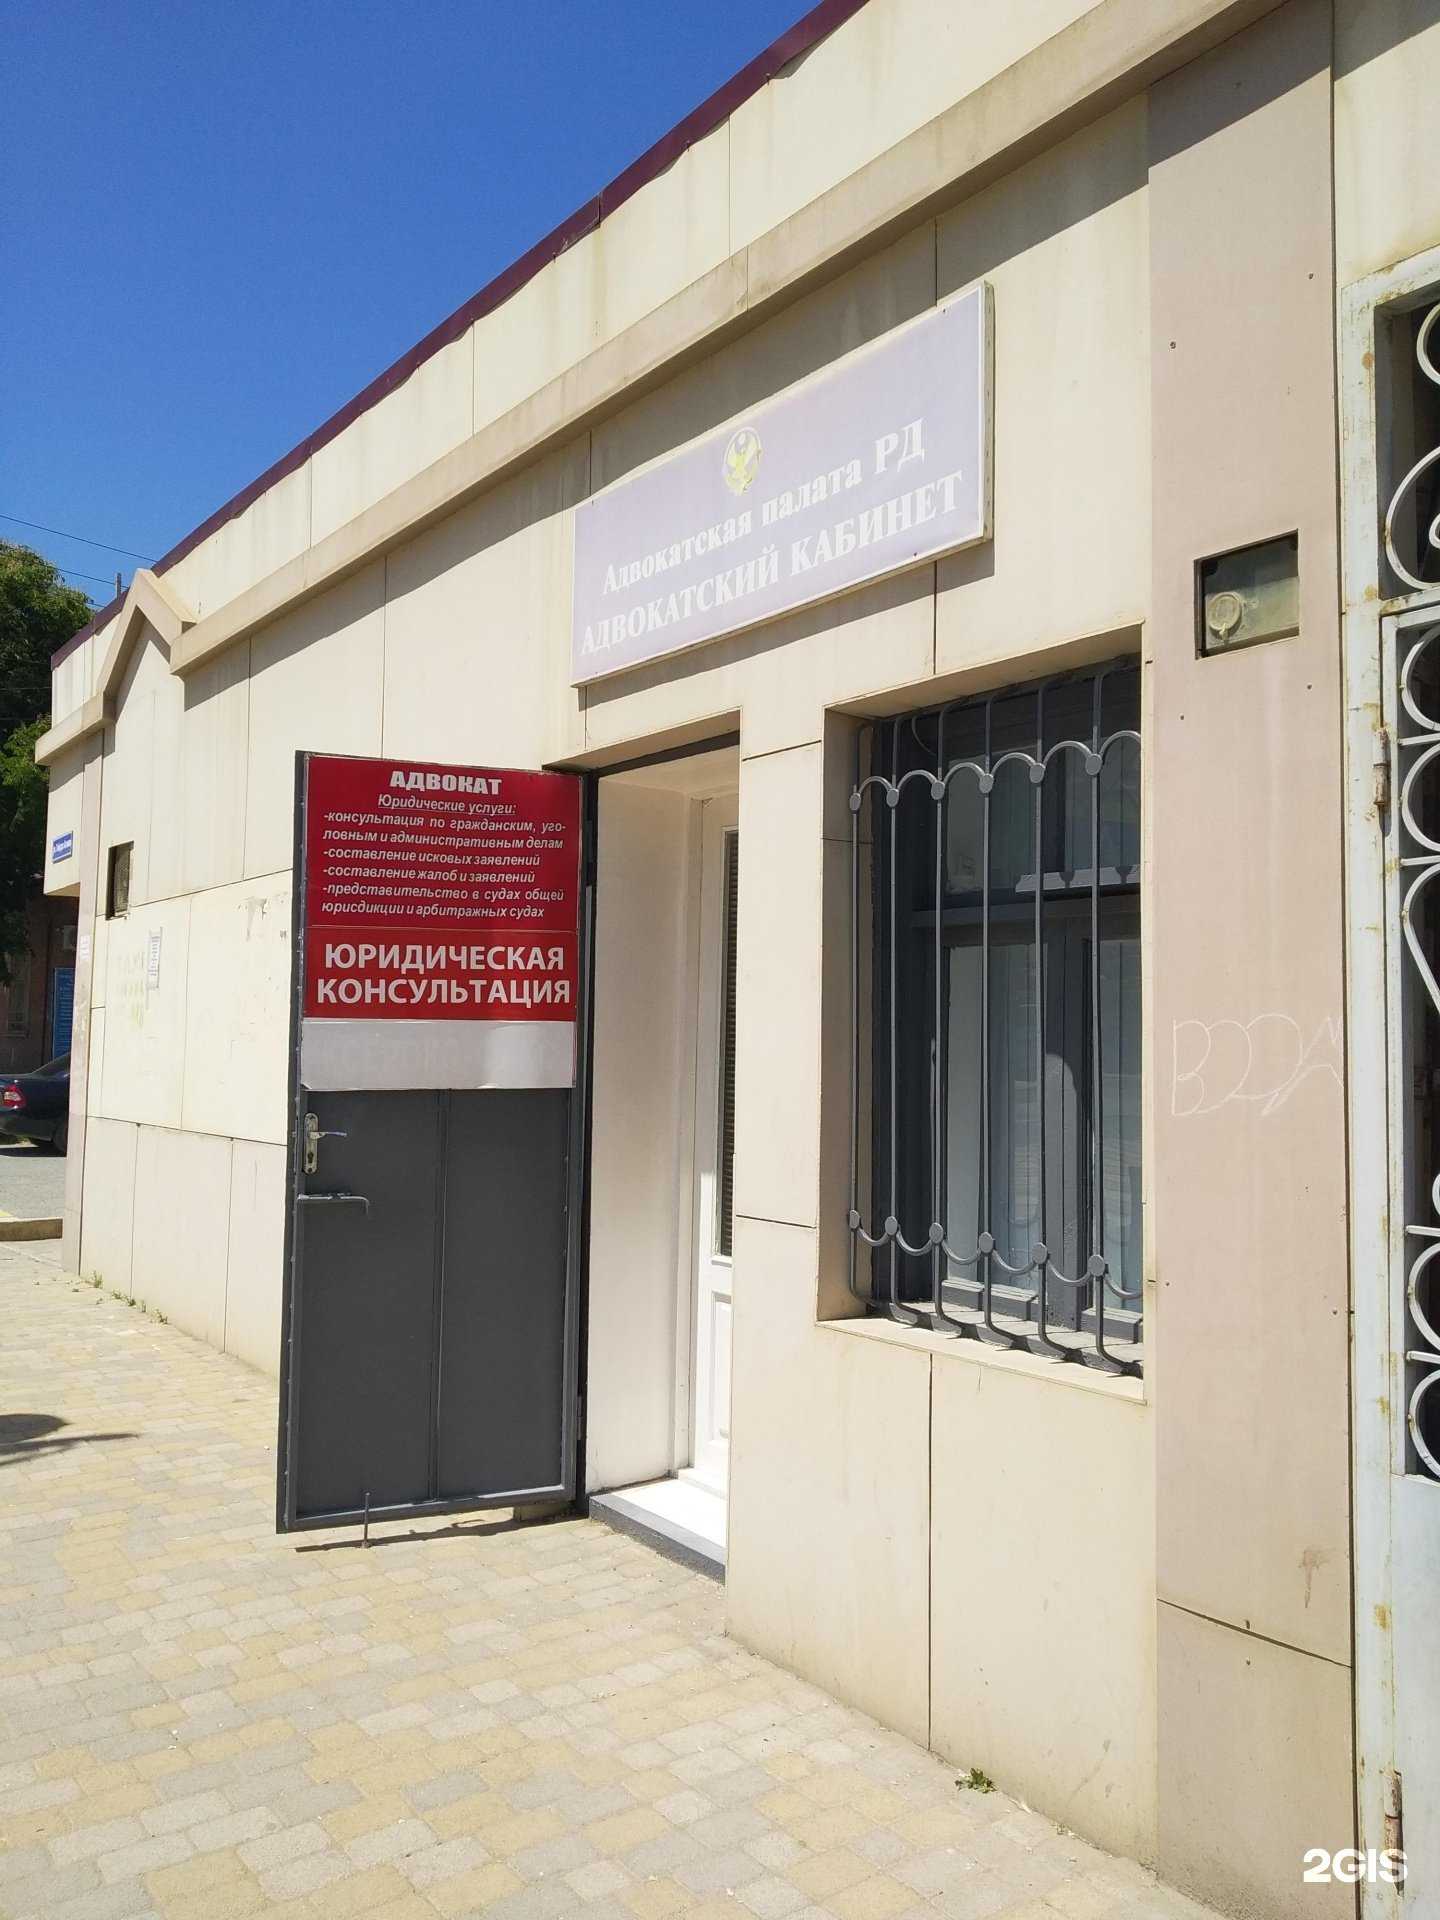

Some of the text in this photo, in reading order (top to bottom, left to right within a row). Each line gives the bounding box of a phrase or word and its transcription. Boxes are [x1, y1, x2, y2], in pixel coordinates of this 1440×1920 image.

[603, 416, 926, 595] Адвокатская палата РД
[581, 470, 963, 656] АДВОКАТСКИЙ КАБИНЕТ
[389, 770, 502, 795] АДВОКАТ
[378, 793, 516, 816] Юридические услуги:
[323, 811, 566, 834] -консультация по гражданским, уго-
[322, 829, 563, 849] ловным и административным делам
[323, 848, 540, 866] -составление исковых заявлений
[323, 866, 536, 883] -составление жалоб и заявлений
[322, 882, 564, 903] -представительство в судах общей
[321, 900, 545, 920] юрисдикции и арбитражных судах
[325, 943, 565, 975] ЮРИДИЧЕСКАЯ
[316, 978, 571, 1009] КОНСУЛЬТАЦИЯ
